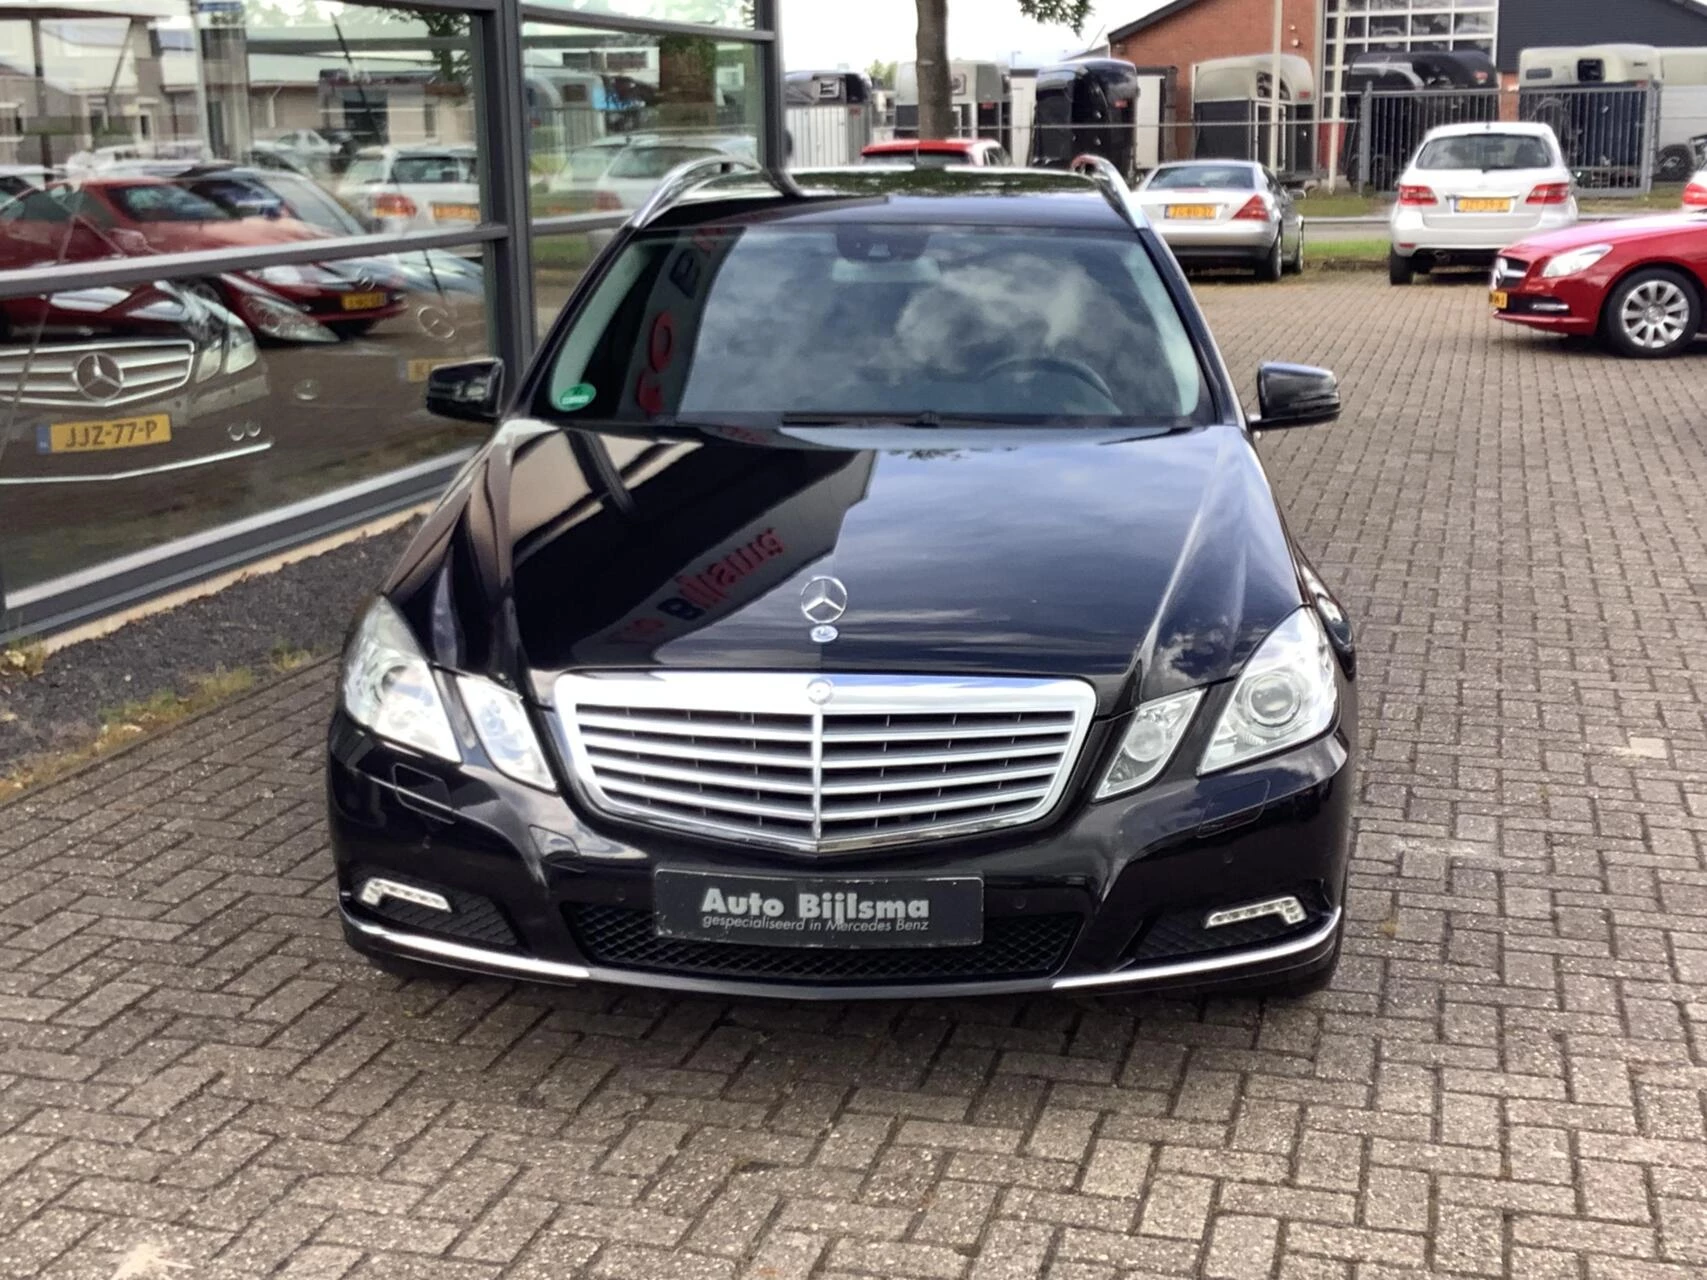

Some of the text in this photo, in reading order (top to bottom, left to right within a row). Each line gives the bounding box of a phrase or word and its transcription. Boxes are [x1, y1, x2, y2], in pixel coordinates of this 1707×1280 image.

[65, 419, 158, 448] JJZ-77-P
[701, 887, 930, 925] Auto Bijlsma
[702, 915, 929, 932] gespecialiseerd in Mercedes Benz
